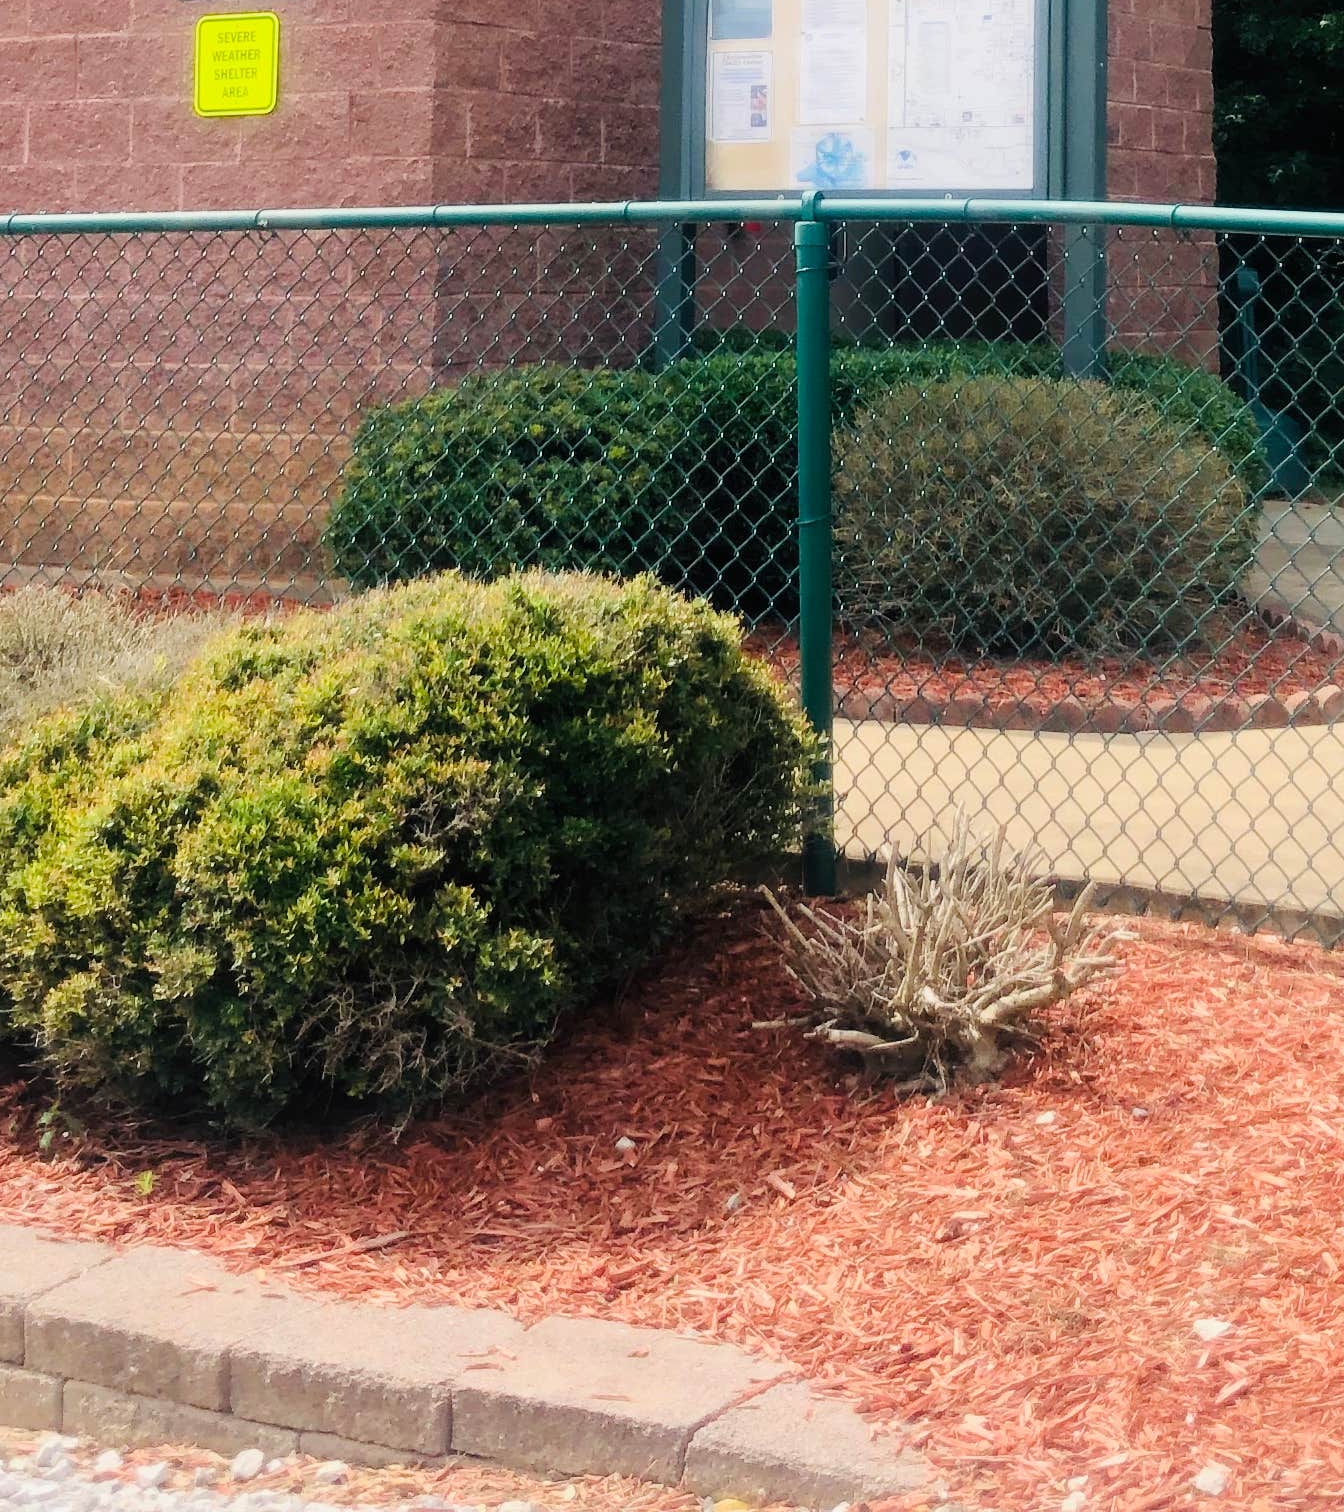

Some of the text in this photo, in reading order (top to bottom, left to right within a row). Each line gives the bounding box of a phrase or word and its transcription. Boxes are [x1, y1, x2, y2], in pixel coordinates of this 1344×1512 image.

[217, 31, 256, 44] SEVERE
[212, 49, 260, 62] WEATHER
[214, 67, 258, 80] SHELTER
[222, 86, 249, 98] AREA
